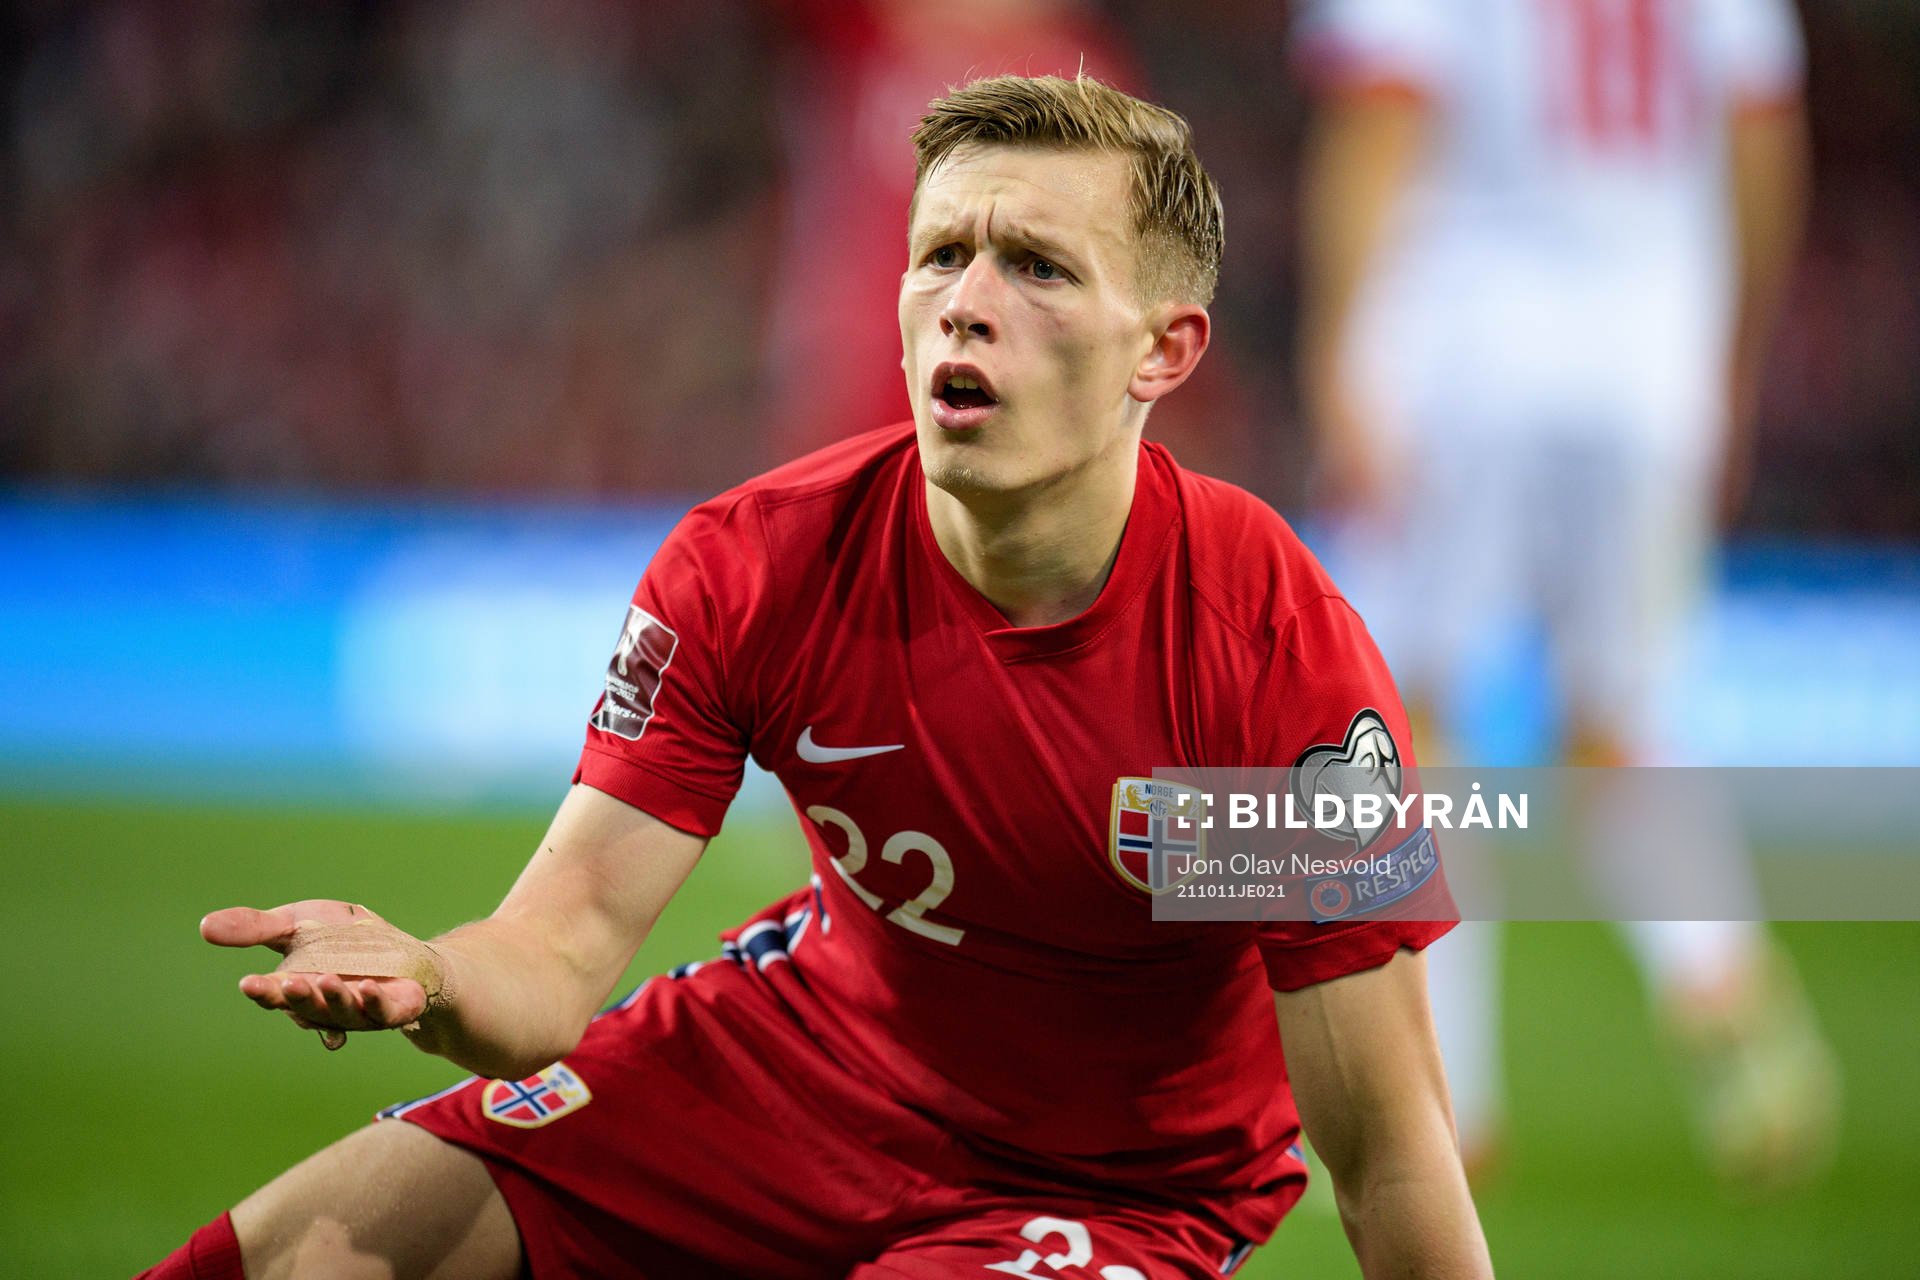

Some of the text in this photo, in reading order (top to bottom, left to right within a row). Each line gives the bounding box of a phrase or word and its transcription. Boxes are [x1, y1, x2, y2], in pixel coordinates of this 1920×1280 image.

[1145, 783, 1174, 798] NORGE
[806, 804, 966, 947] 22
[1355, 833, 1435, 901] RESPECT
